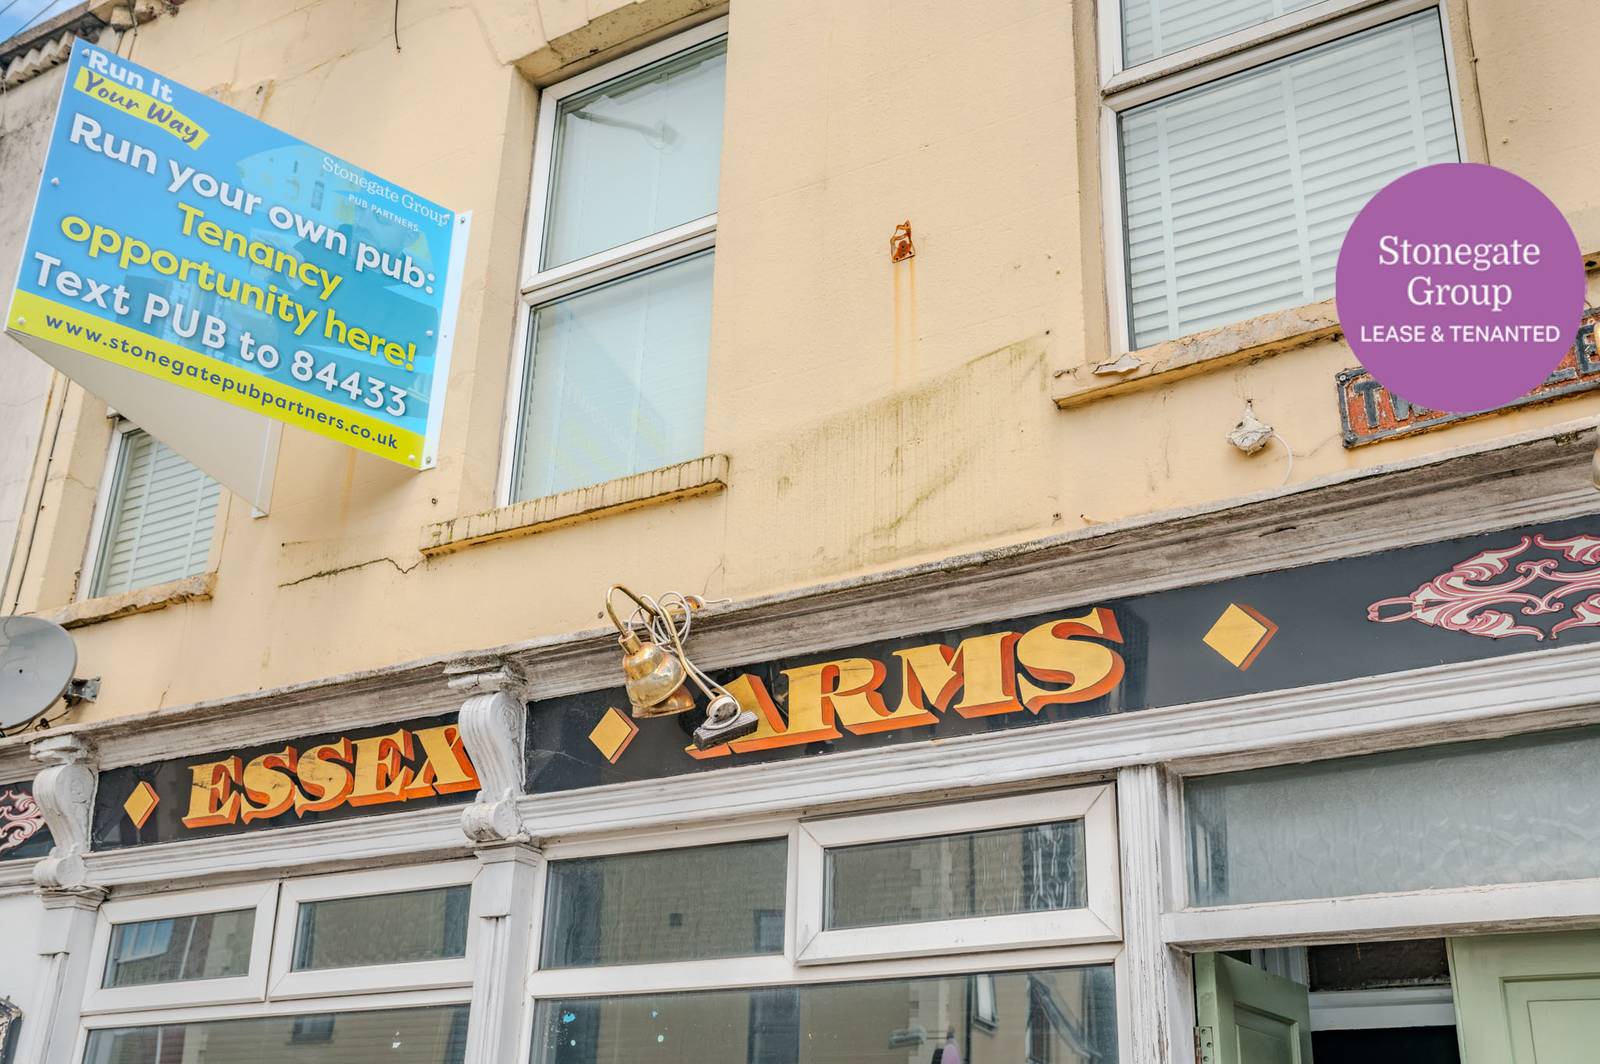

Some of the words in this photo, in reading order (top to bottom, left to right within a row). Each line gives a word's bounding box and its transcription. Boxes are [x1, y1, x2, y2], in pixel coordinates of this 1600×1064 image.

[85, 70, 140, 110] Your
[146, 102, 200, 143] Way
[89, 49, 144, 90] Run
[151, 78, 173, 103] It
[69, 112, 158, 175] Run
[168, 158, 262, 216] your
[268, 203, 348, 256] own
[355, 241, 437, 295] pub:
[322, 156, 399, 203] Stonegate
[401, 194, 450, 228] Group
[348, 193, 368, 208] PUB
[370, 204, 419, 232] PARTNERS
[60, 215, 319, 337] opportunity
[324, 314, 417, 372] here!
[178, 202, 343, 300] Tenancy
[33, 252, 131, 316] Text
[143, 294, 227, 351] PUB
[240, 333, 280, 369] to
[290, 350, 408, 418] 84433
[45, 314, 399, 450] www.stonegatepubpartners.co.uk
[181, 724, 481, 829] ESSEX
[685, 607, 1124, 760] ARMS
